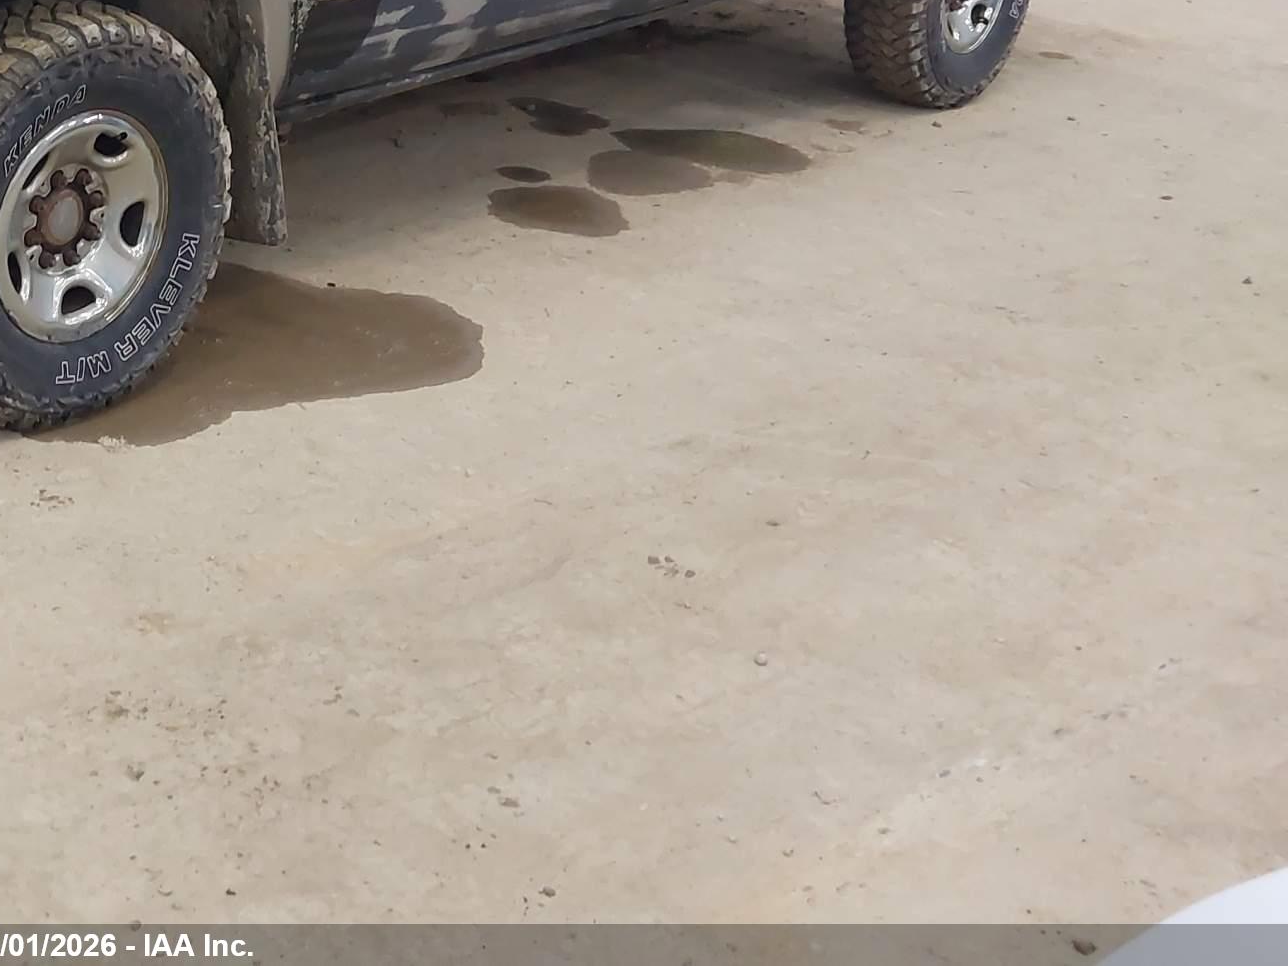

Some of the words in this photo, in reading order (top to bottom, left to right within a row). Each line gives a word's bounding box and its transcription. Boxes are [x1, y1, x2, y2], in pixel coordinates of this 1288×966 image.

[3, 83, 87, 178] KENDA
[113, 232, 201, 362] KLEVER
[55, 350, 112, 385] M/T
